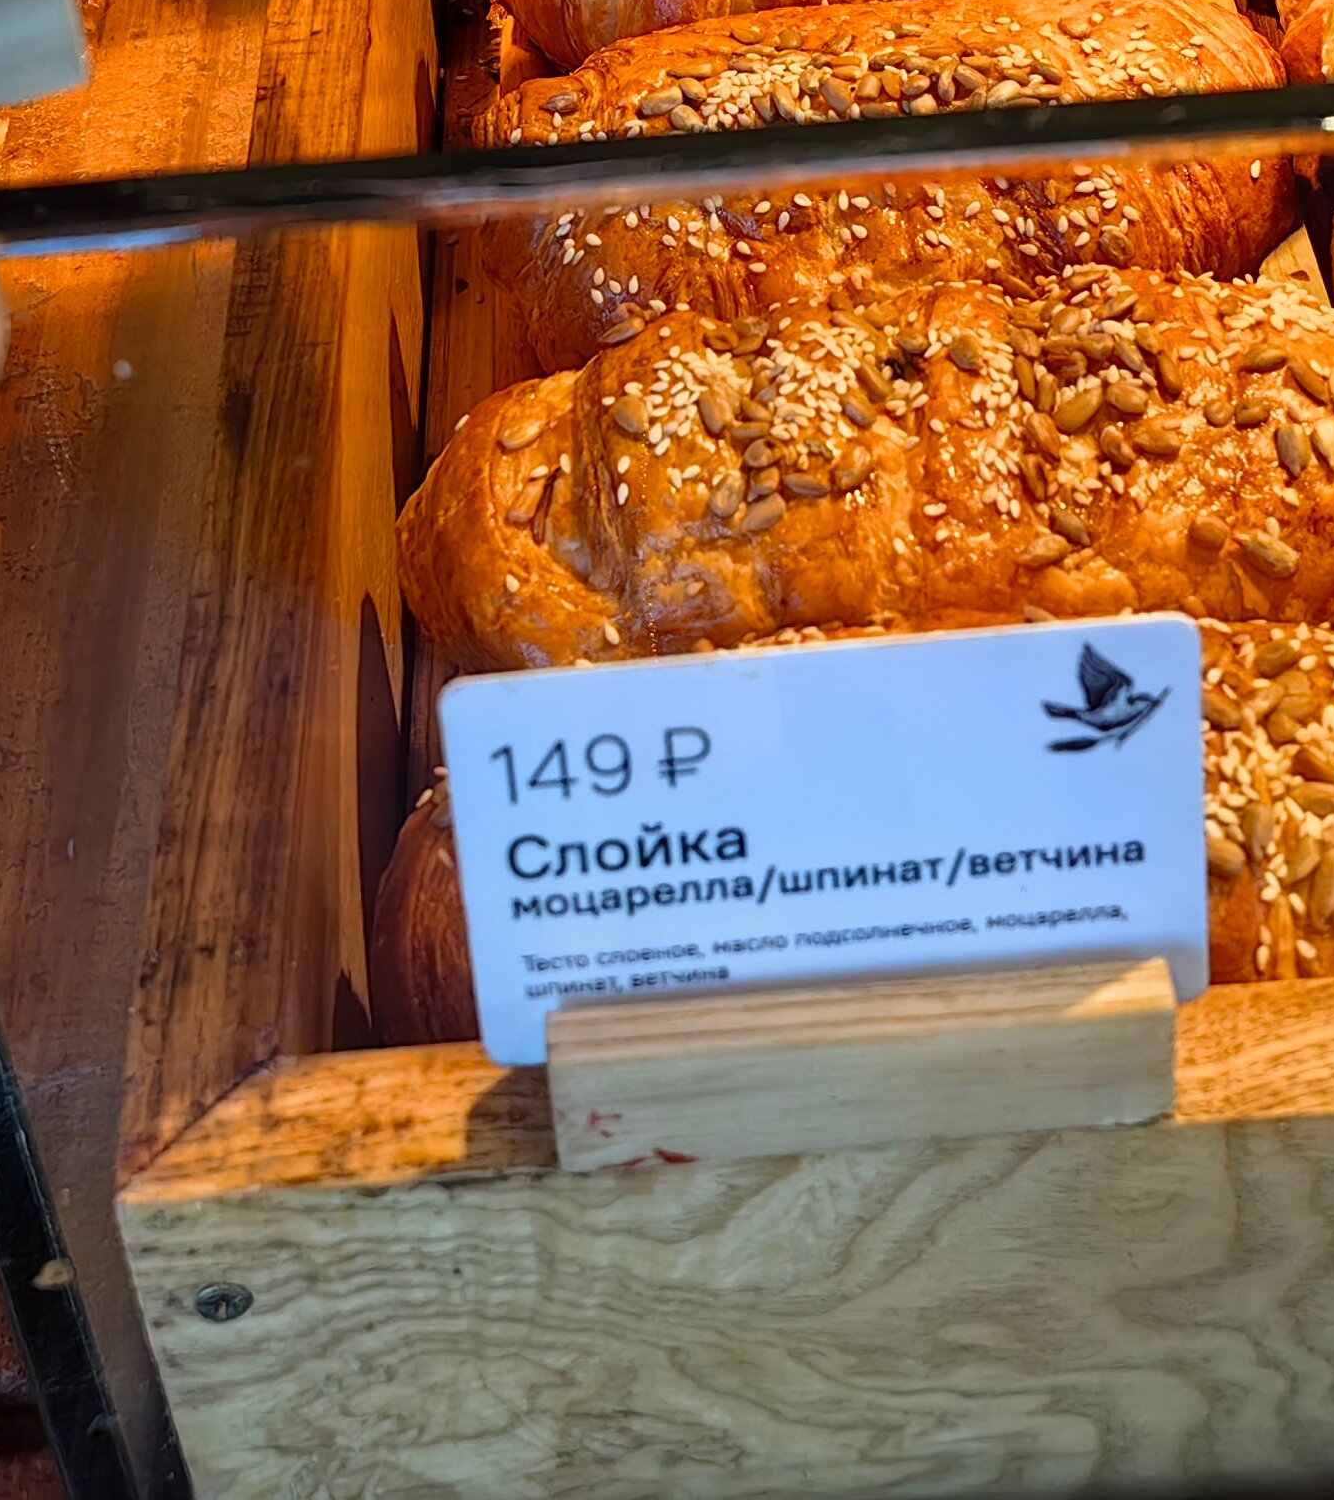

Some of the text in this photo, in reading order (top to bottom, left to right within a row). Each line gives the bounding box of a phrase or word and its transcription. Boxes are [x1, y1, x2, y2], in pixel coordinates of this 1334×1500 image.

[490, 726, 712, 805] 149 ₽
[507, 821, 749, 880] Слойка
[511, 839, 1147, 921] моцарелла/шпинат/ветчина
[522, 902, 1129, 972] Тесто слоеное, масло подсолнечное, моцарелла,
[526, 965, 731, 998] шпинат, ветчина
